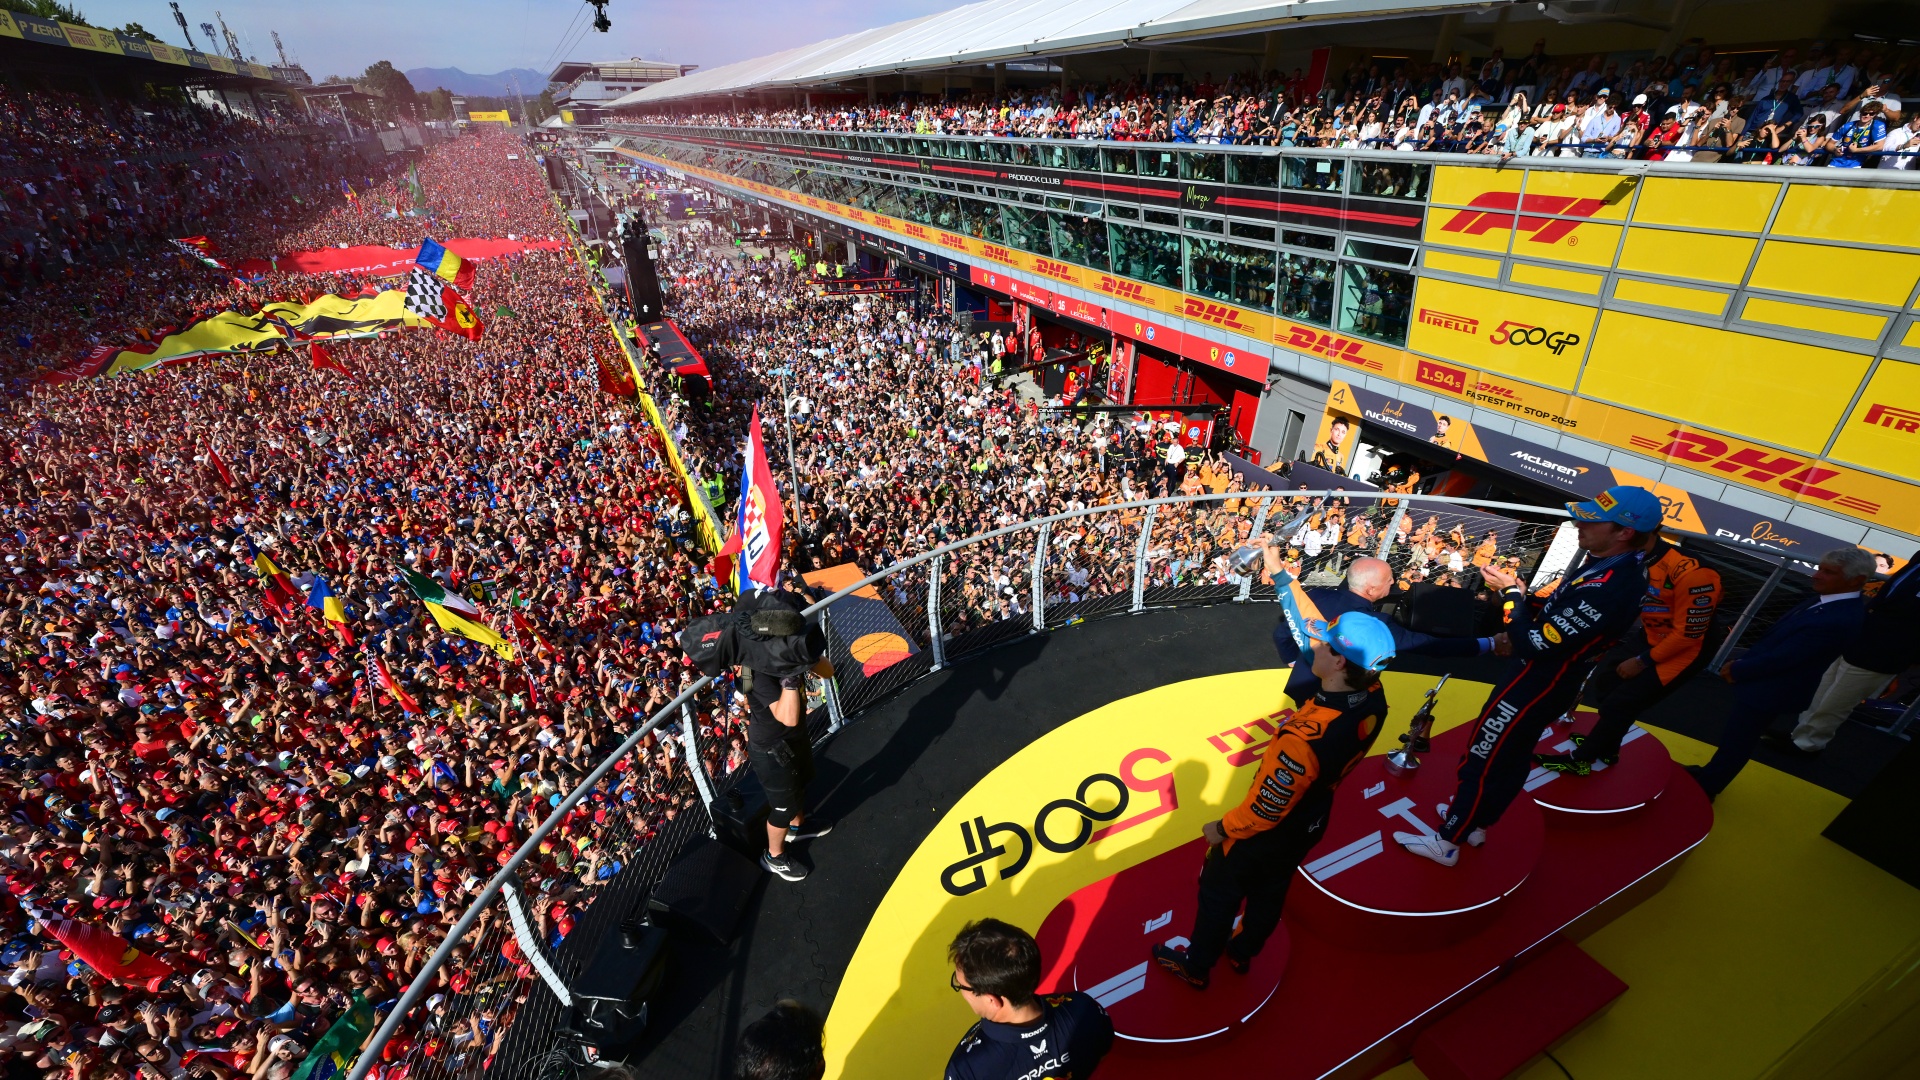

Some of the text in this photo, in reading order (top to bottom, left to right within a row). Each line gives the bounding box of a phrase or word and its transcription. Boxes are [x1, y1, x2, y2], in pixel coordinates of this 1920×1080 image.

[18, 21, 63, 38] P ZERO
[65, 27, 97, 48] PIRELLI
[1008, 173, 1061, 185] PADDOCK CLUB
[874, 215, 893, 230] DHL
[1440, 191, 1611, 244] F1
[905, 223, 926, 238] DHL
[940, 233, 966, 250] DHL
[984, 244, 1013, 264] DHL
[1035, 258, 1073, 281] DHL
[1100, 275, 1147, 302] DHL
[1070, 310, 1097, 323] LECLERC
[1184, 298, 1244, 330] DHL
[1418, 308, 1479, 335] PIRELLI
[1287, 326, 1369, 366] DHL
[1489, 320, 1580, 356] 500GP
[1333, 388, 1345, 405] 4
[1476, 382, 1515, 399] DHL
[1381, 400, 1405, 418] Lando
[1466, 390, 1578, 428] FASTEST PIT STOP 2025
[1365, 409, 1418, 432] NORRIS
[1510, 450, 1578, 477] McLaren
[1520, 463, 1548, 477] FORMULA
[1557, 476, 1573, 485] TEAM
[1658, 429, 1842, 501] DHL
[1751, 520, 1800, 547] Oscar
[1571, 615, 1590, 629] AT&T
[1577, 600, 1602, 622] VISA
[1283, 608, 1305, 647] avenga
[1020, 1022, 1049, 1040] HONDA
